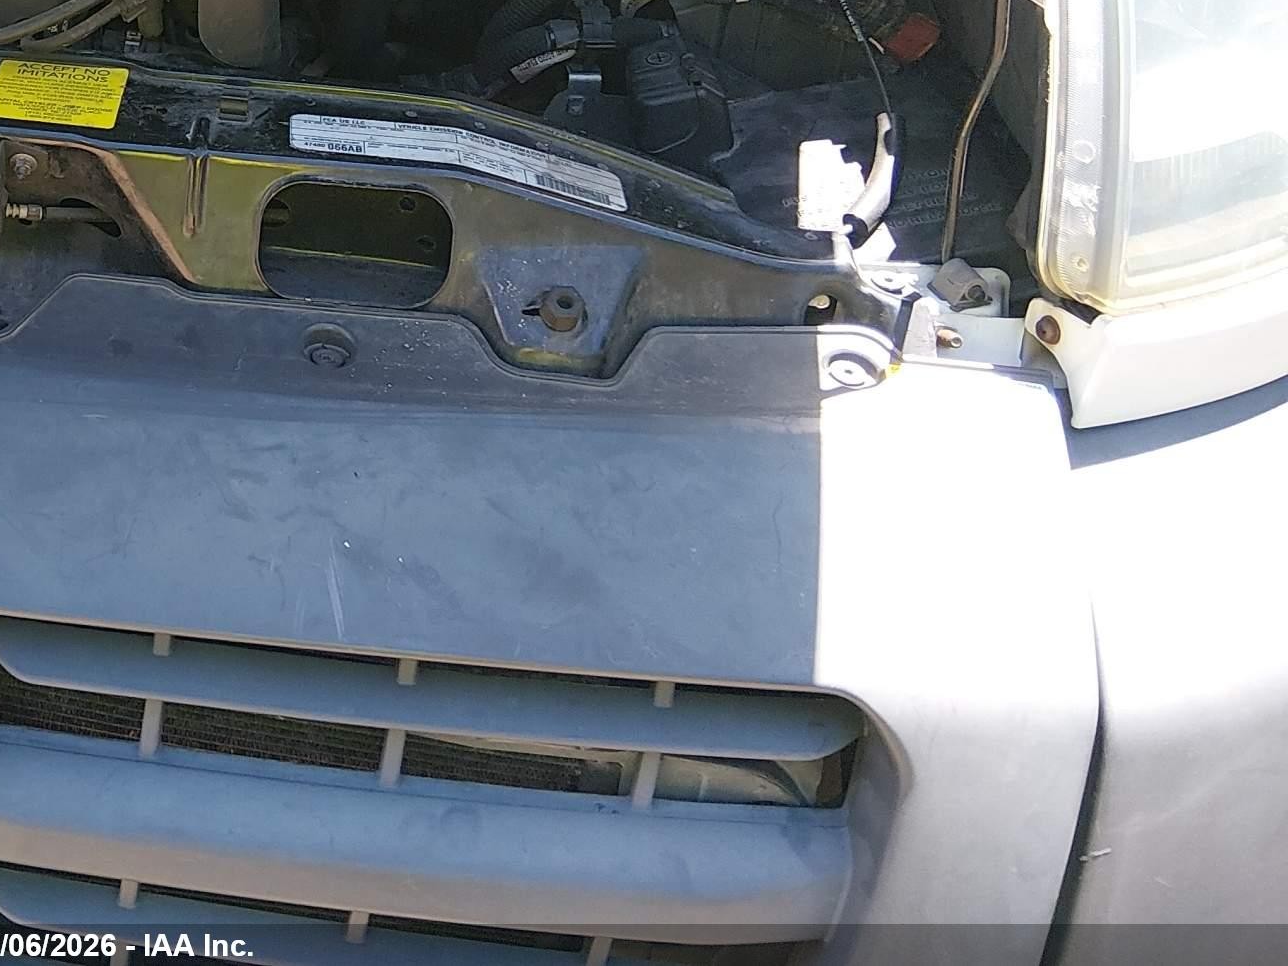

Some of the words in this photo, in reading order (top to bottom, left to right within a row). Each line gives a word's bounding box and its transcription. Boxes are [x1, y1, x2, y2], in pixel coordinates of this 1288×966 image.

[17, 62, 81, 74] ACCEPT
[84, 67, 111, 77] NO
[17, 68, 109, 83] IMITATIONS
[397, 123, 427, 131] VEHICLE
[465, 130, 496, 144] CONTROL
